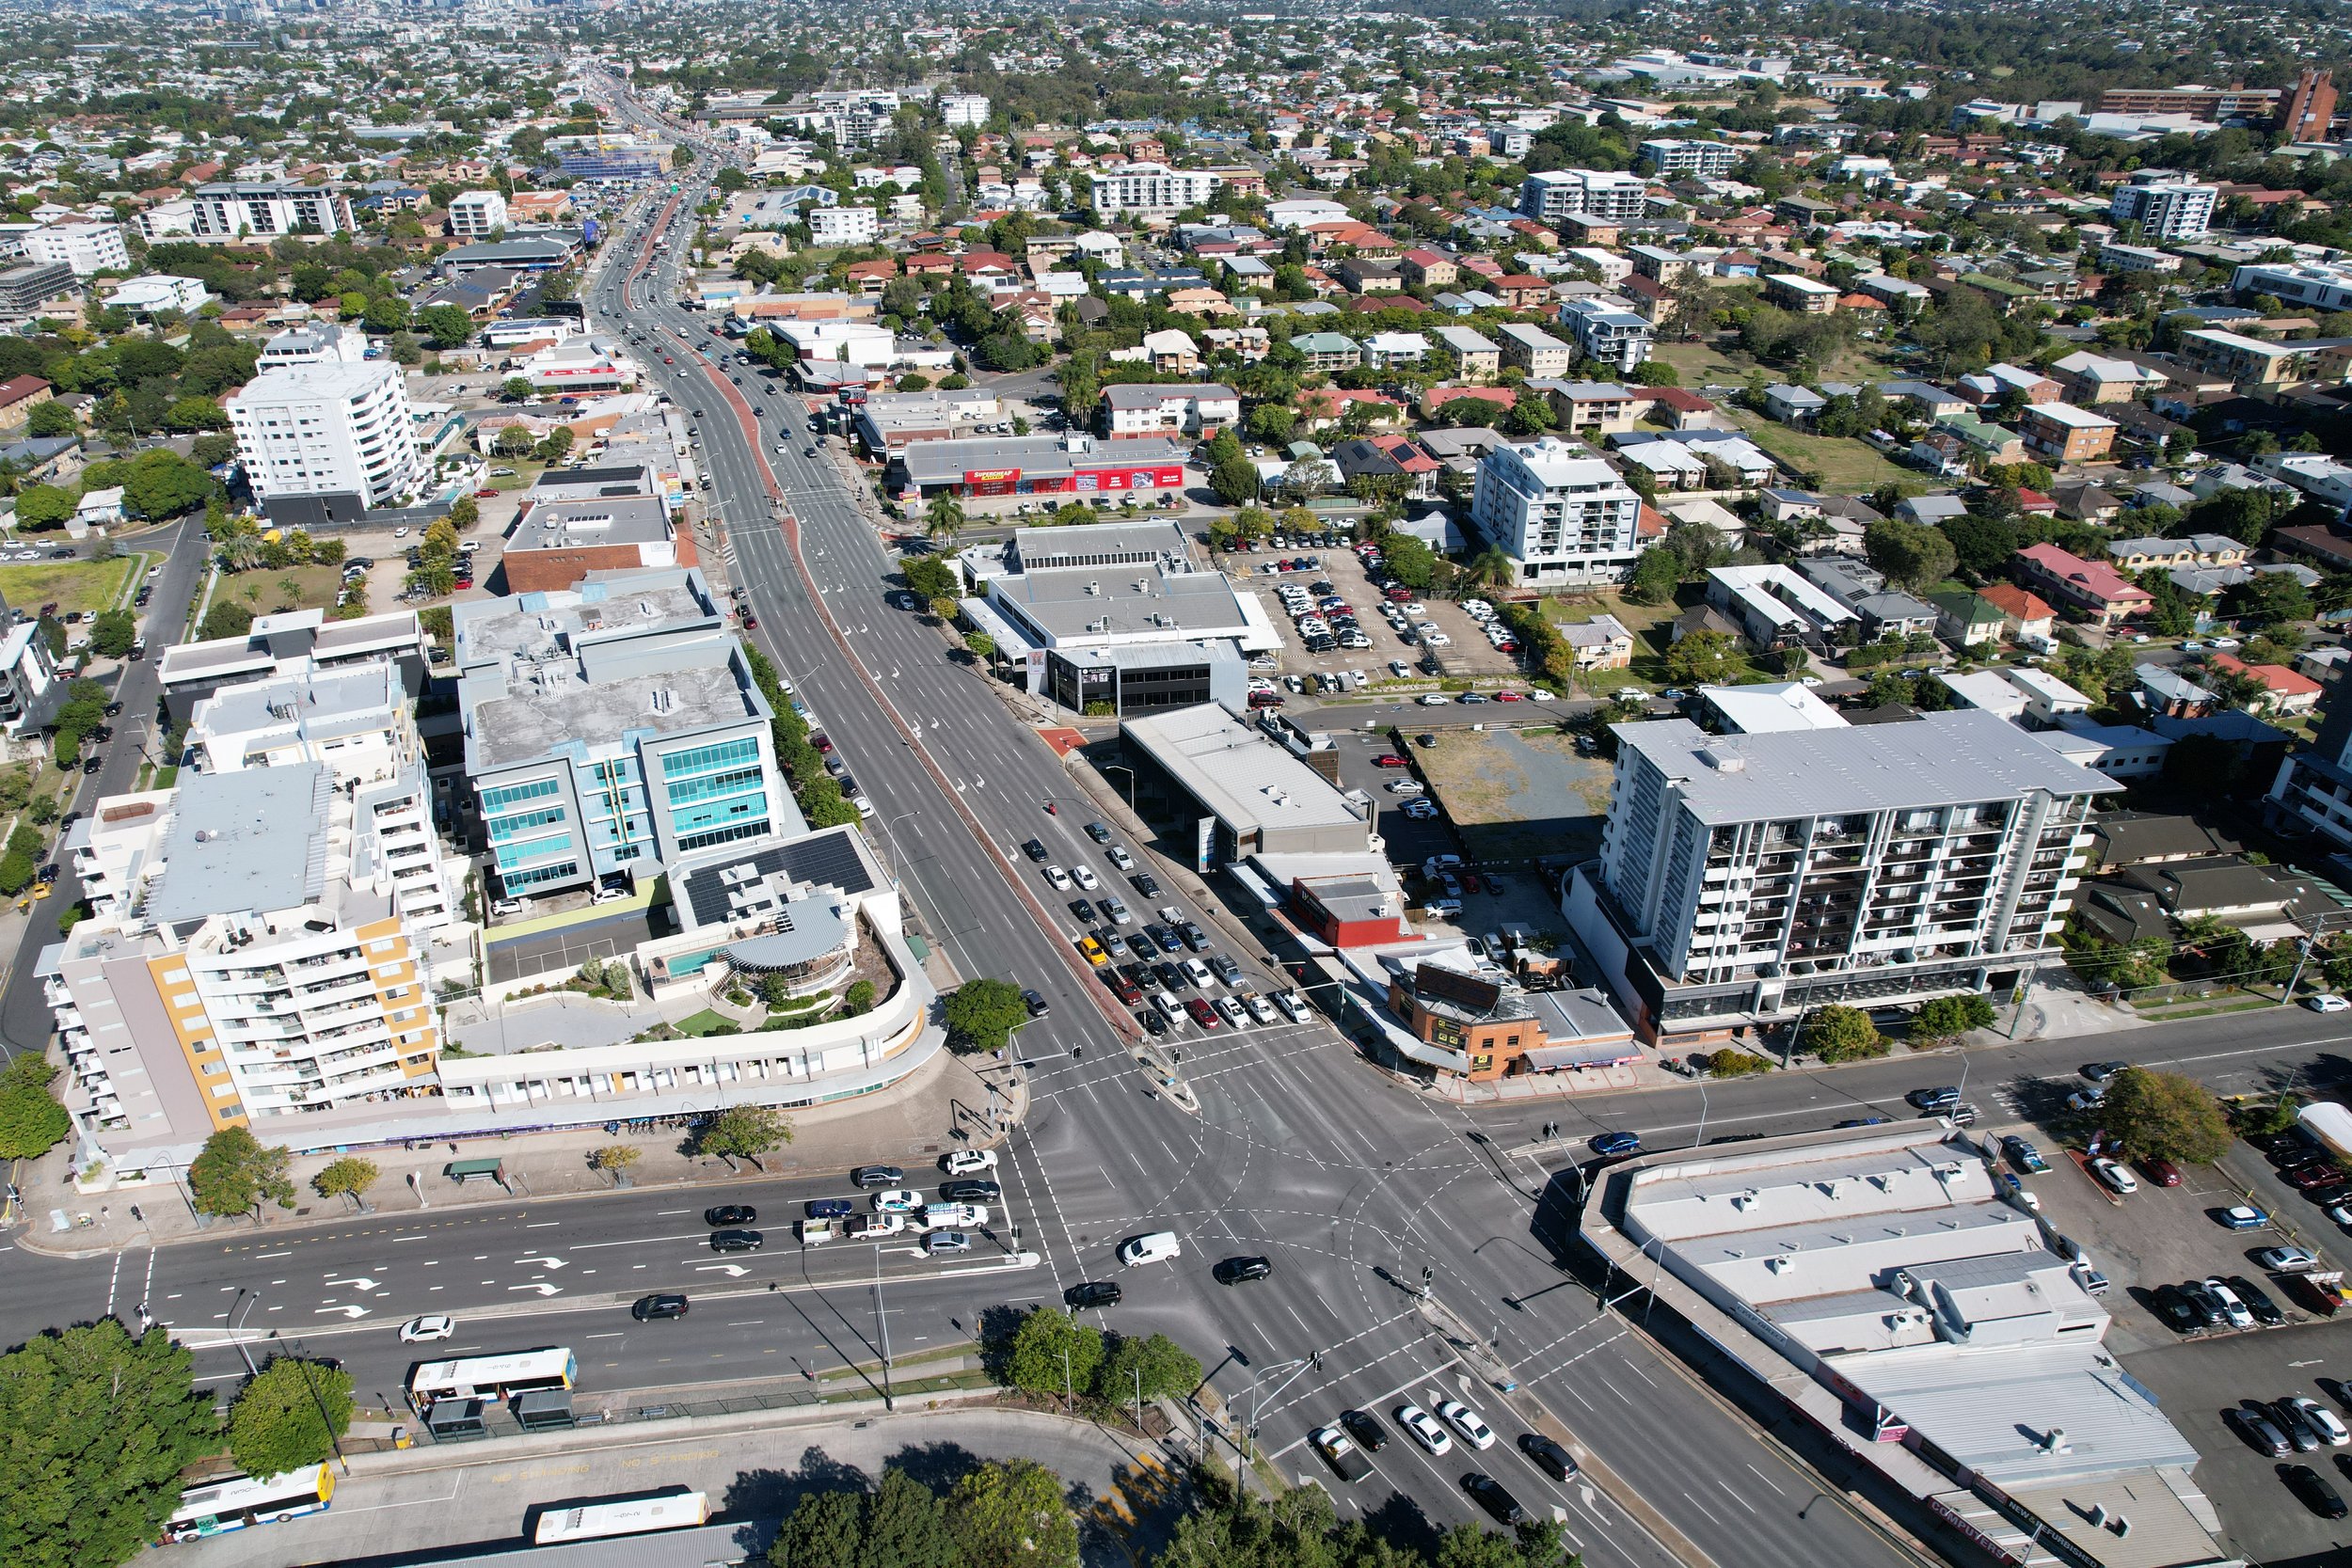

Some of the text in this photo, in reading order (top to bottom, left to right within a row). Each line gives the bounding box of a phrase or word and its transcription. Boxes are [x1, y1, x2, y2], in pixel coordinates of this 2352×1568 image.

[622, 1458, 641, 1468] NO
[491, 1473, 512, 1483] NO
[2009, 1500, 2030, 1519] NEW
[1931, 1501, 2006, 1560] COMPUTERS
